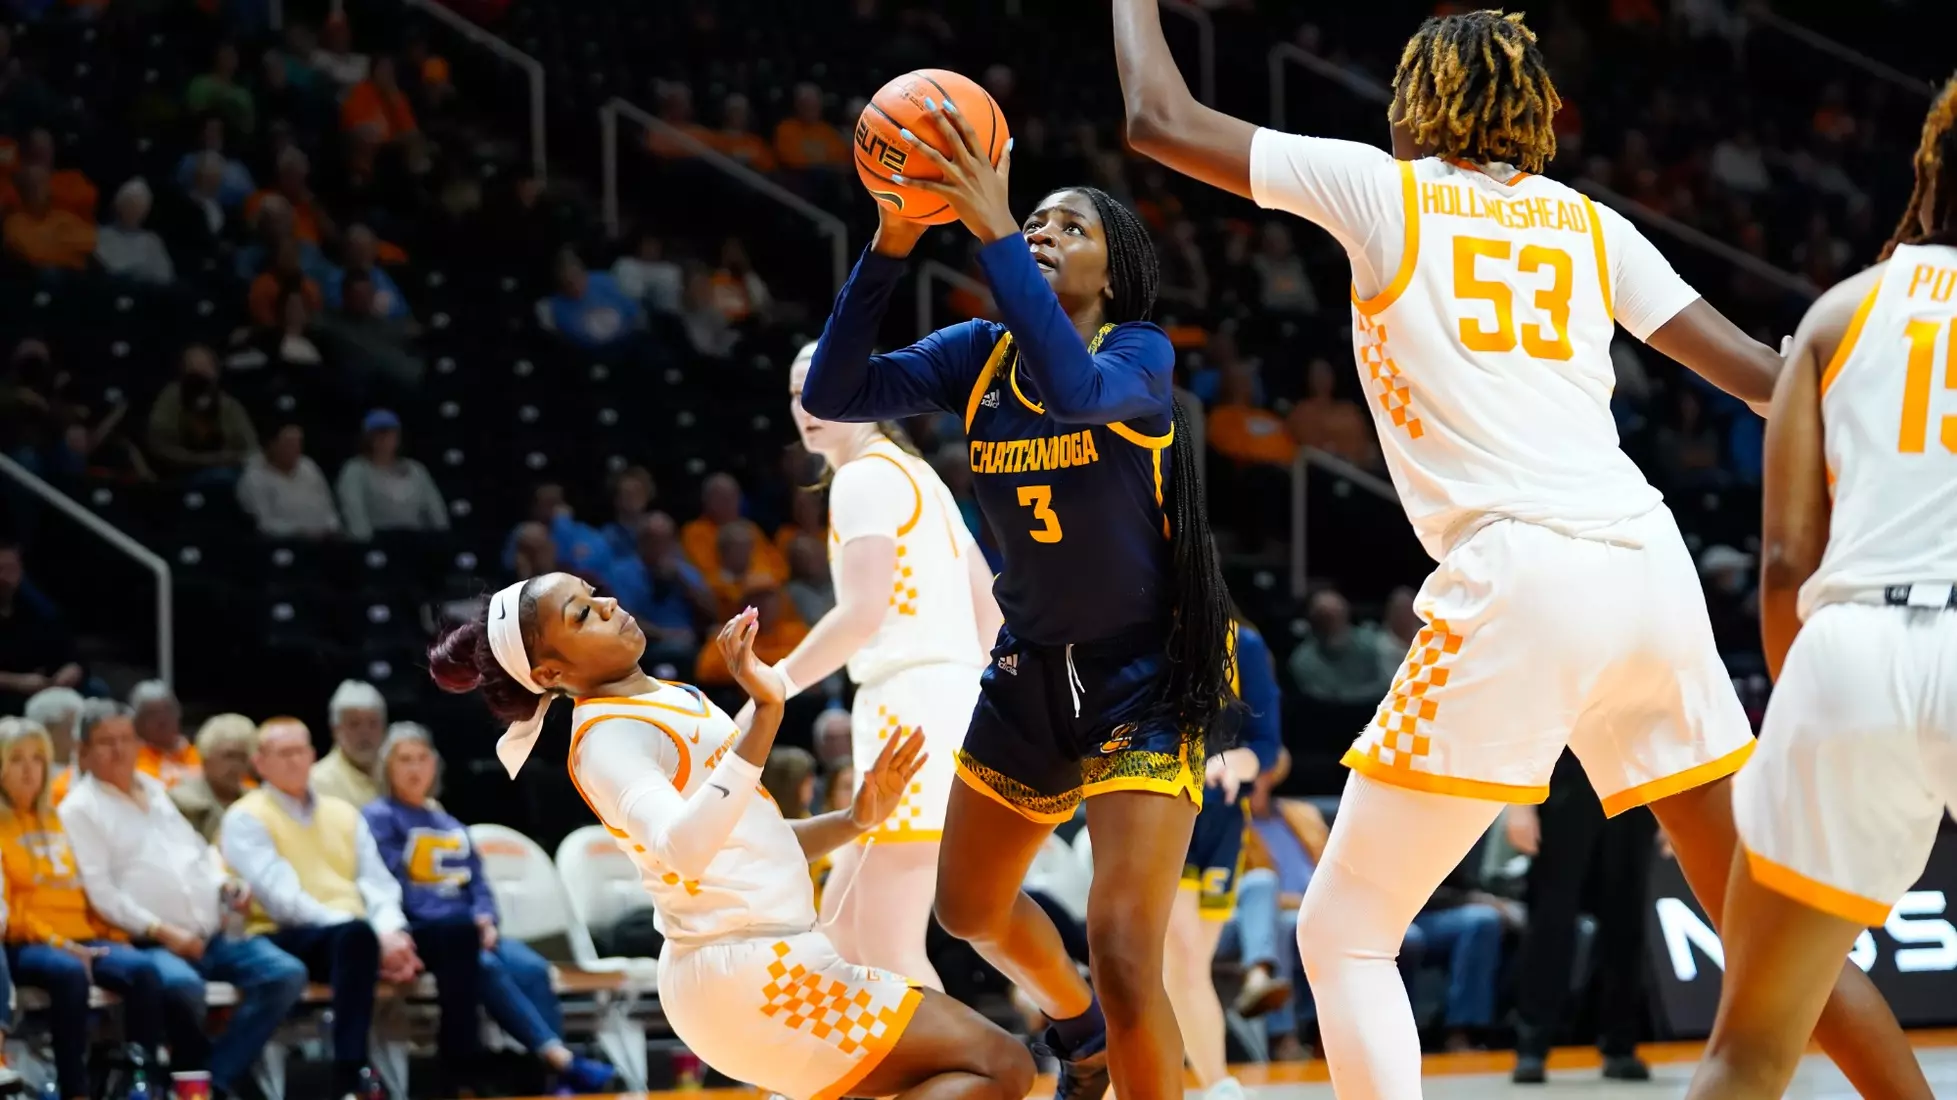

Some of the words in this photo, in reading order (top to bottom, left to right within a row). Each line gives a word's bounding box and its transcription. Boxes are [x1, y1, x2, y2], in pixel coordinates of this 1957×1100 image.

[855, 119, 908, 173] ELITE
[1452, 235, 1574, 361] 53
[970, 429, 1098, 474] CHATTANOOGA
[1016, 485, 1063, 544] 3
